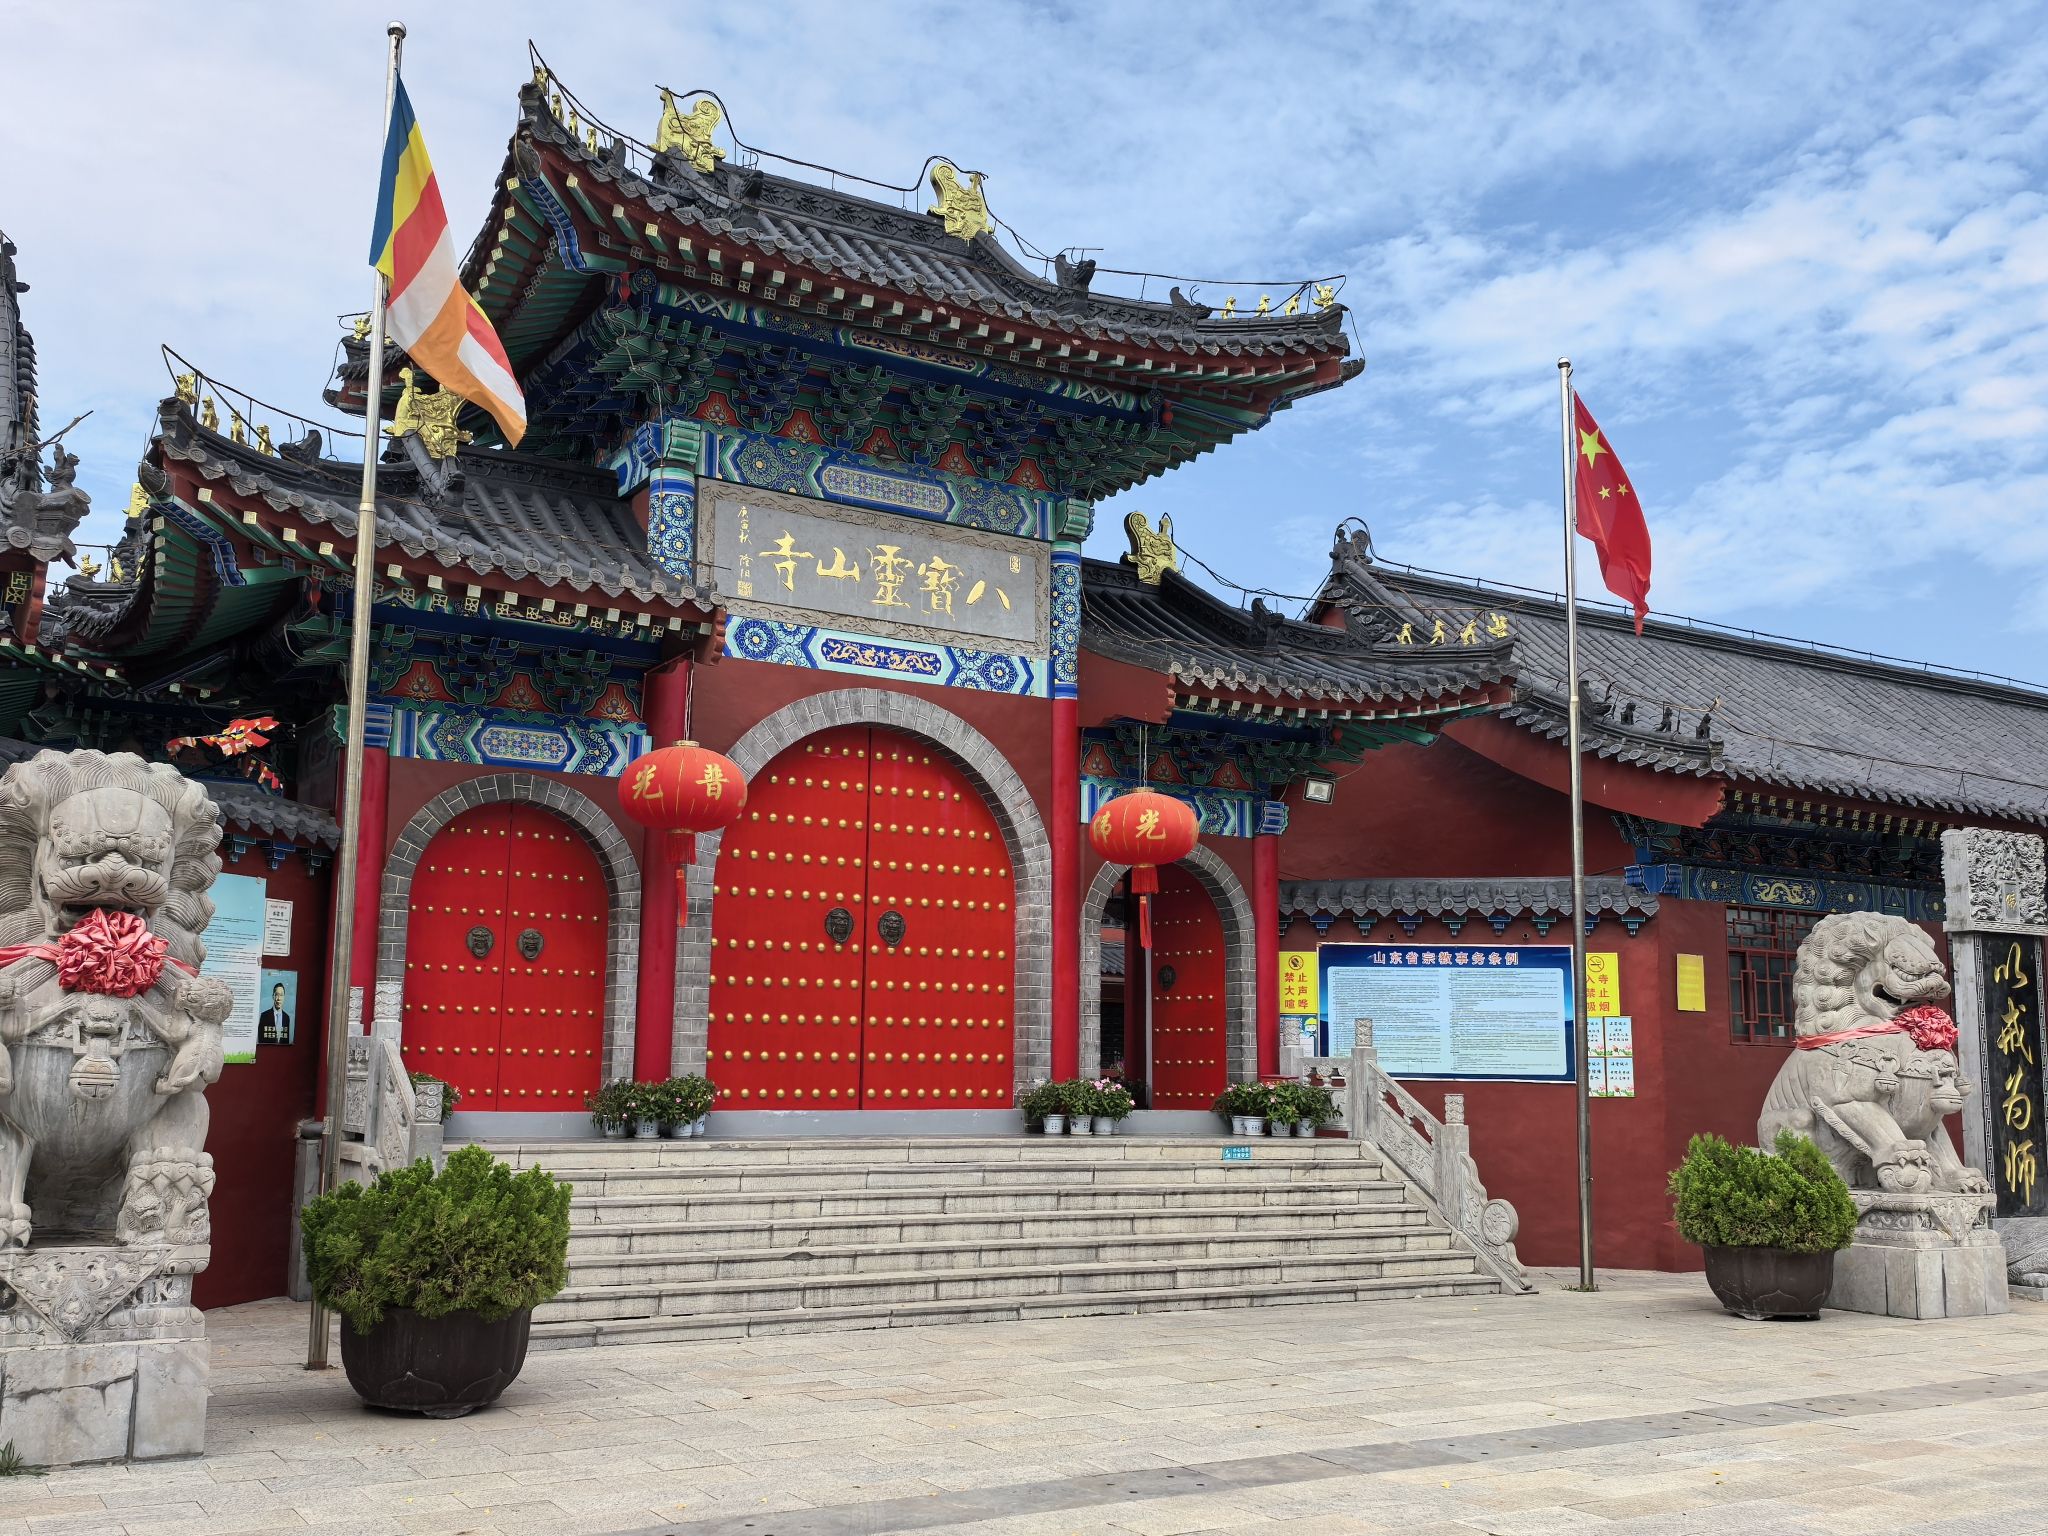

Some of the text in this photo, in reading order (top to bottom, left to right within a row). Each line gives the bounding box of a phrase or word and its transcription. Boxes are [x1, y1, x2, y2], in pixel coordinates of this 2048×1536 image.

[1373, 951, 1519, 965] 山东省宗教事务条例
[1284, 972, 1308, 983] 禁止
[1586, 974, 1608, 984] 入寺
[1284, 985, 1308, 996] 大声
[1284, 999, 1309, 1009] 喧哗
[1587, 1001, 1610, 1012] 吸烟
[1993, 942, 2035, 1208] 以戒为师
